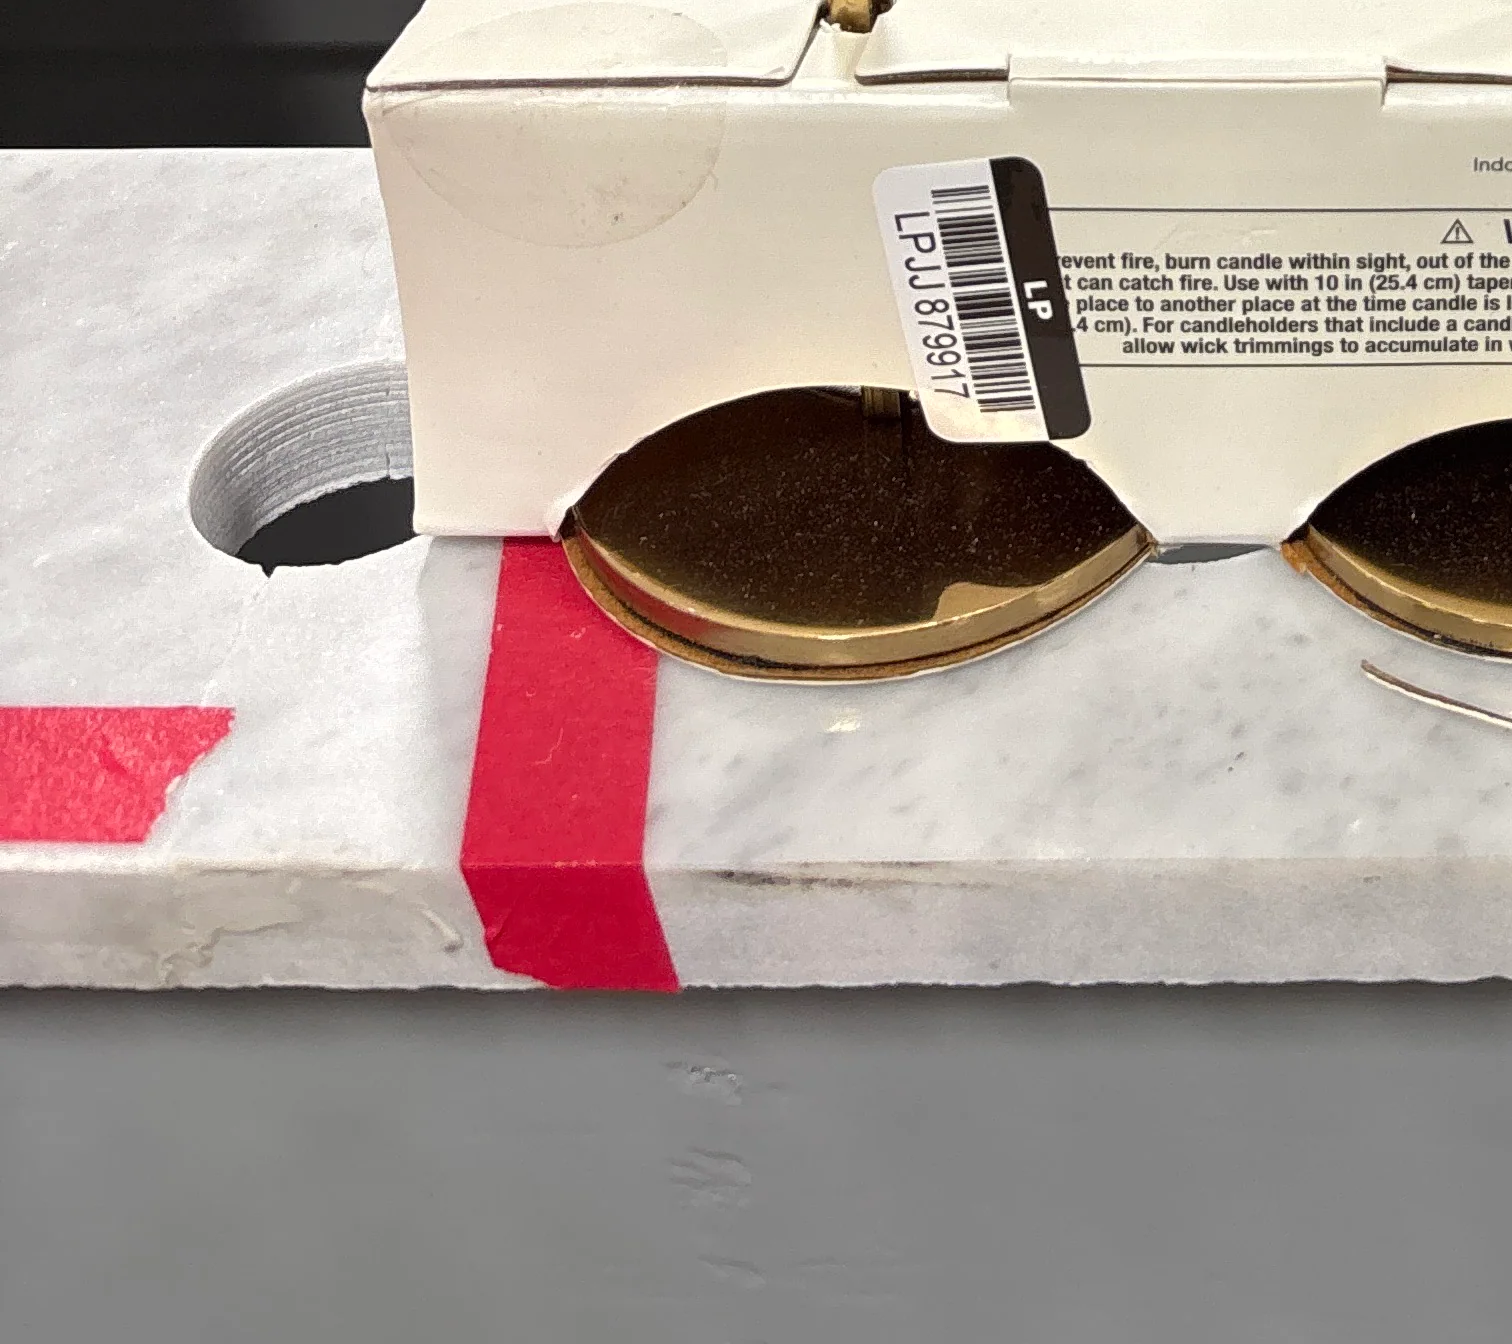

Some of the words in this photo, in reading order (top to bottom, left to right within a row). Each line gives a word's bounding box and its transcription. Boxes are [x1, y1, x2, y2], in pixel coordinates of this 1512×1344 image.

[1120, 252, 1160, 272] fire,
[1165, 253, 1211, 270] burn
[1216, 253, 1283, 271] candle
[1288, 253, 1350, 270] within
[1356, 253, 1411, 273] sight,
[1416, 253, 1450, 269] out
[1454, 252, 1474, 269] of
[1479, 252, 1510, 269] the
[1077, 277, 1114, 291] can
[1119, 274, 1174, 291] catch
[1179, 274, 1218, 291] fire.
[1224, 274, 1260, 291] Use
[1265, 274, 1309, 291] with
[1314, 274, 1339, 291] 10
[1345, 274, 1362, 291] in
[1369, 272, 1418, 294] (25.4
[1423, 274, 1460, 293] cm)
[1022, 280, 1053, 321] LP
[1076, 295, 1129, 315] place
[1134, 296, 1154, 312] to
[1160, 296, 1236, 312] another
[1242, 296, 1295, 315] place
[1300, 296, 1321, 312] at
[1325, 295, 1357, 312] the
[1362, 295, 1406, 312] time
[1412, 295, 1478, 311] candle
[1483, 294, 1500, 313] is
[1094, 317, 1137, 336] cm).
[1143, 317, 1174, 333] For
[1180, 317, 1319, 333] candleholders
[1324, 317, 1364, 333] that
[1369, 316, 1440, 332] include
[1446, 319, 1457, 332] a
[1123, 338, 1175, 354] allow
[1180, 337, 1229, 354] wick
[1233, 337, 1334, 357] trimmings
[1339, 338, 1359, 353] to
[1365, 336, 1479, 353] accumulate
[1485, 336, 1502, 352] in
